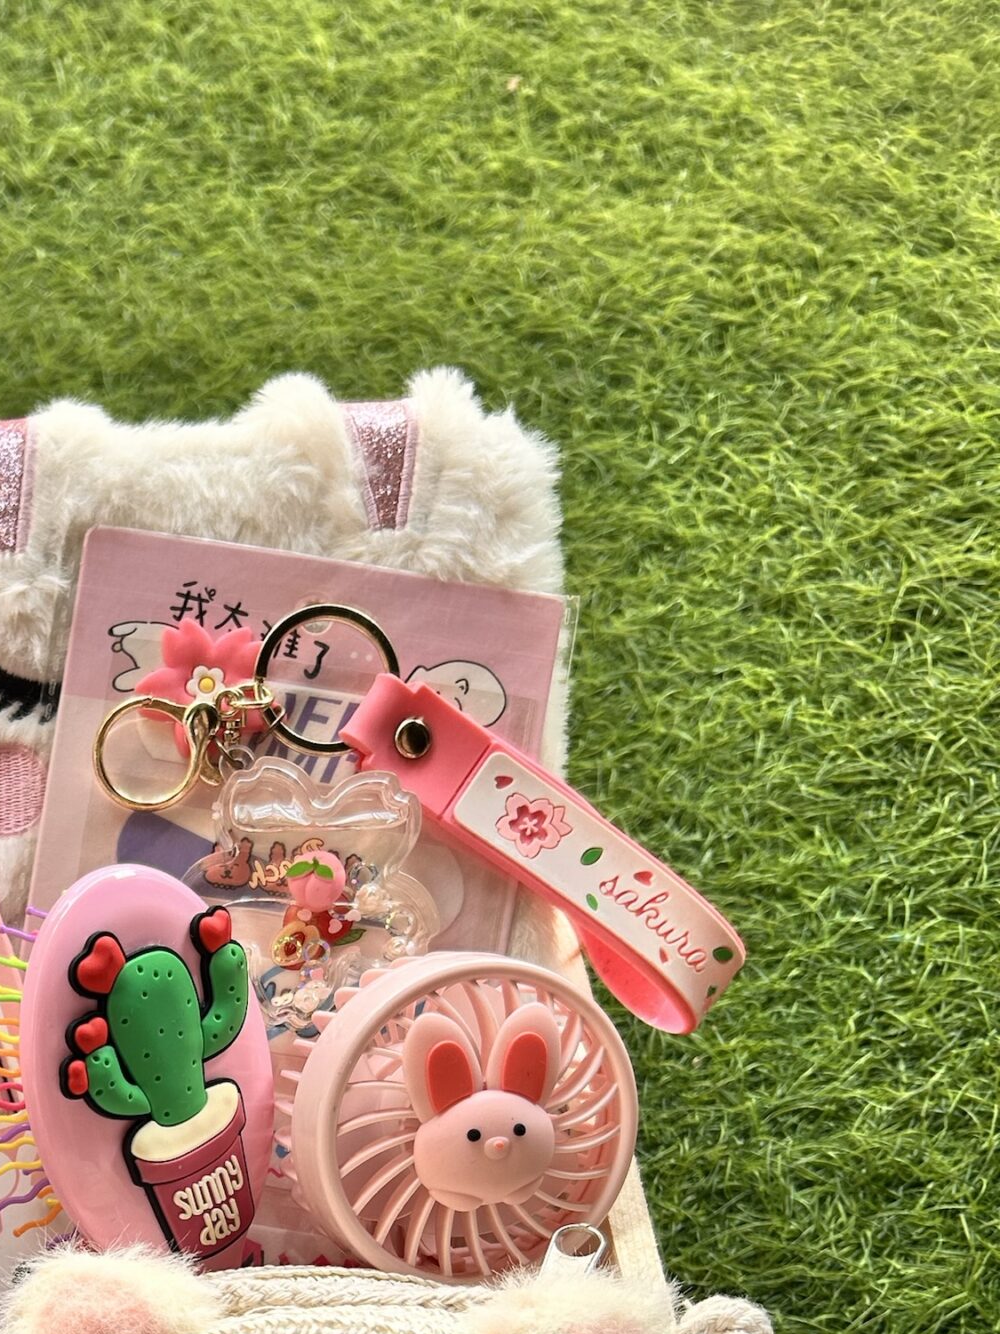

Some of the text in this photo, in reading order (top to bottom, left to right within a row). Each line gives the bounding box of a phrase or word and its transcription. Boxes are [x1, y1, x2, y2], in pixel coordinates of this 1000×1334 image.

[598, 874, 708, 974] sakura
[172, 1154, 245, 1221] sunny
[199, 1197, 242, 1246] day
